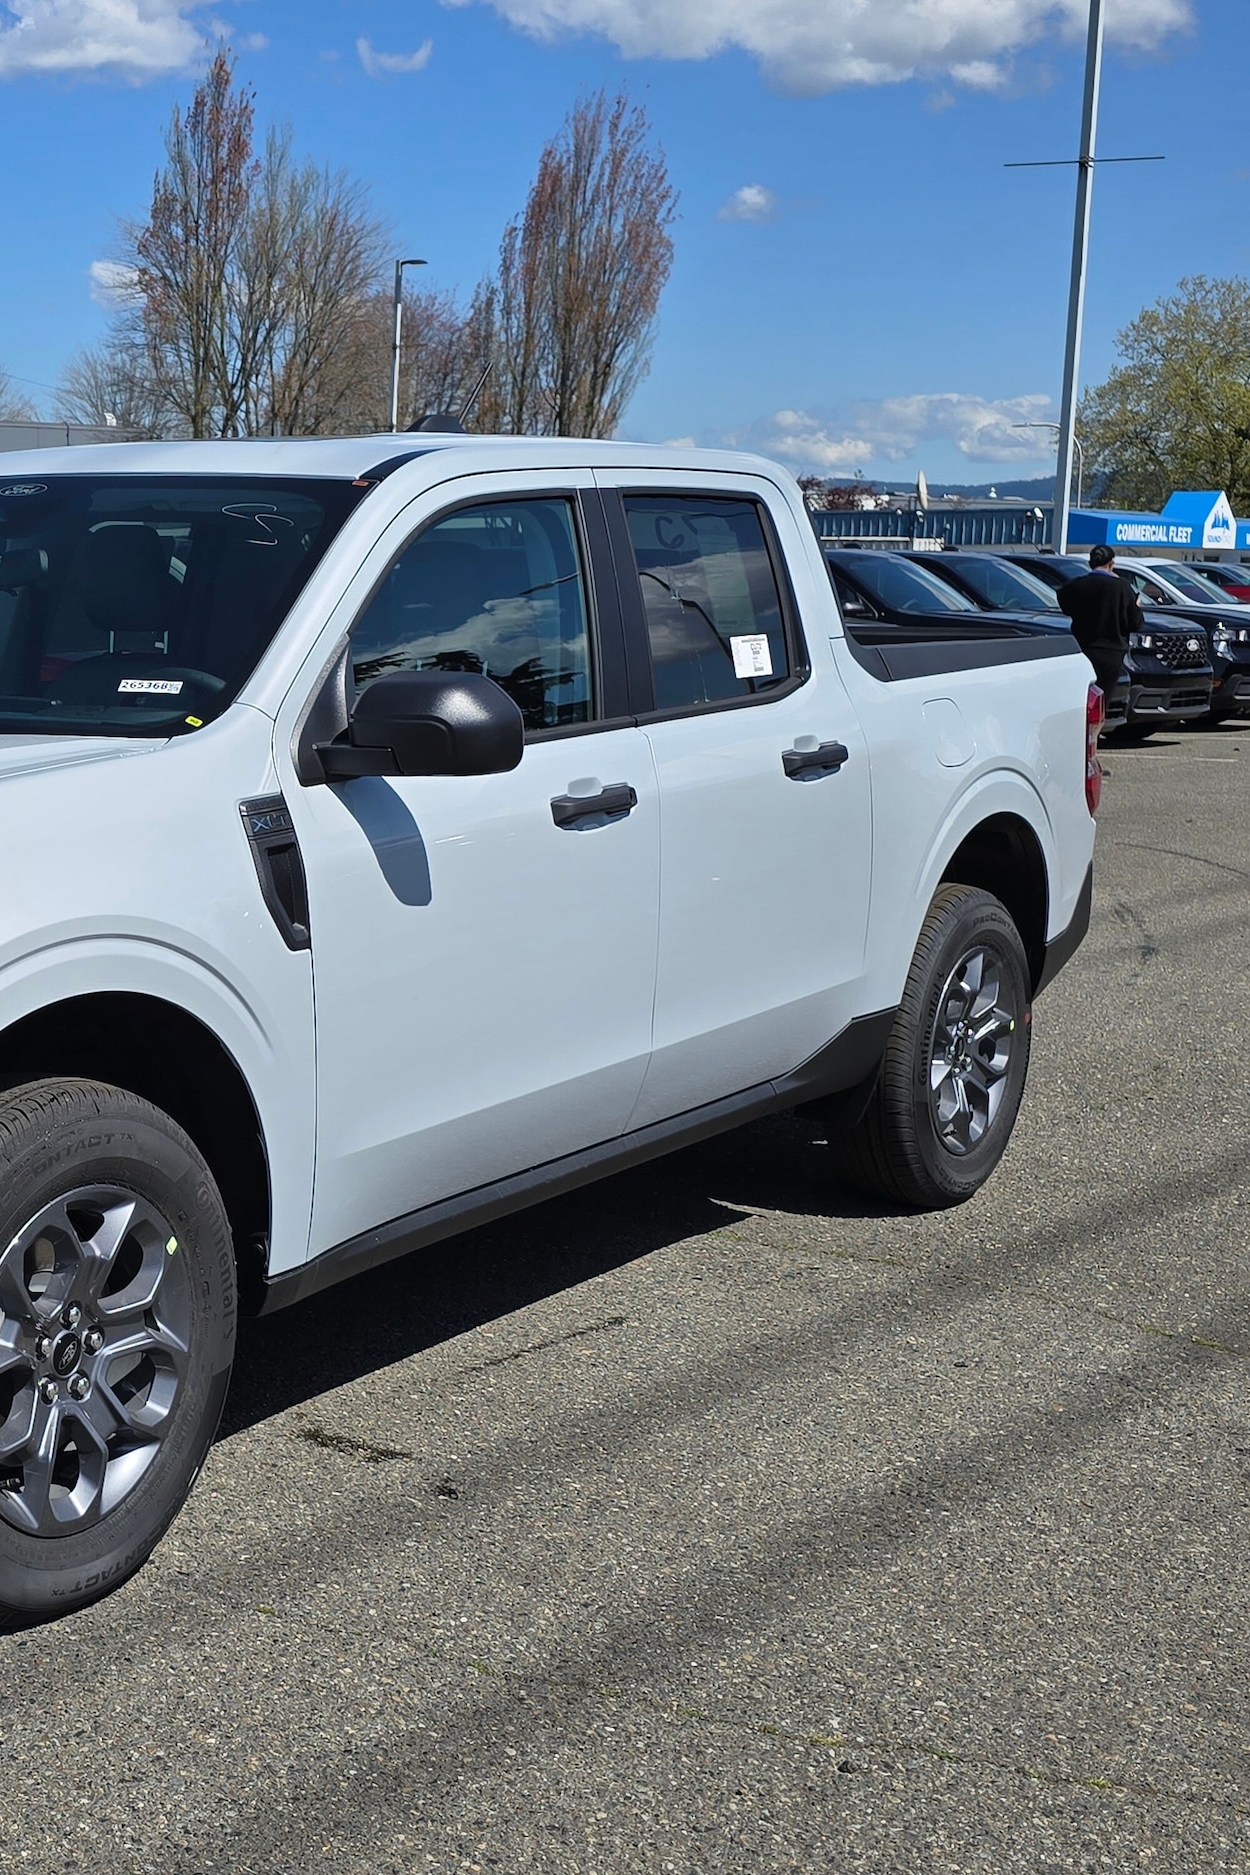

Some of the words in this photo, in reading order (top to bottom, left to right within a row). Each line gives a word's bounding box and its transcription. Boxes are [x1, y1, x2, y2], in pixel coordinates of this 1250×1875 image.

[1116, 523, 1168, 542] COMMERCIAL
[1169, 526, 1193, 544] FLEET
[918, 983, 941, 1086] Continental
[193, 1181, 235, 1320] Continental
